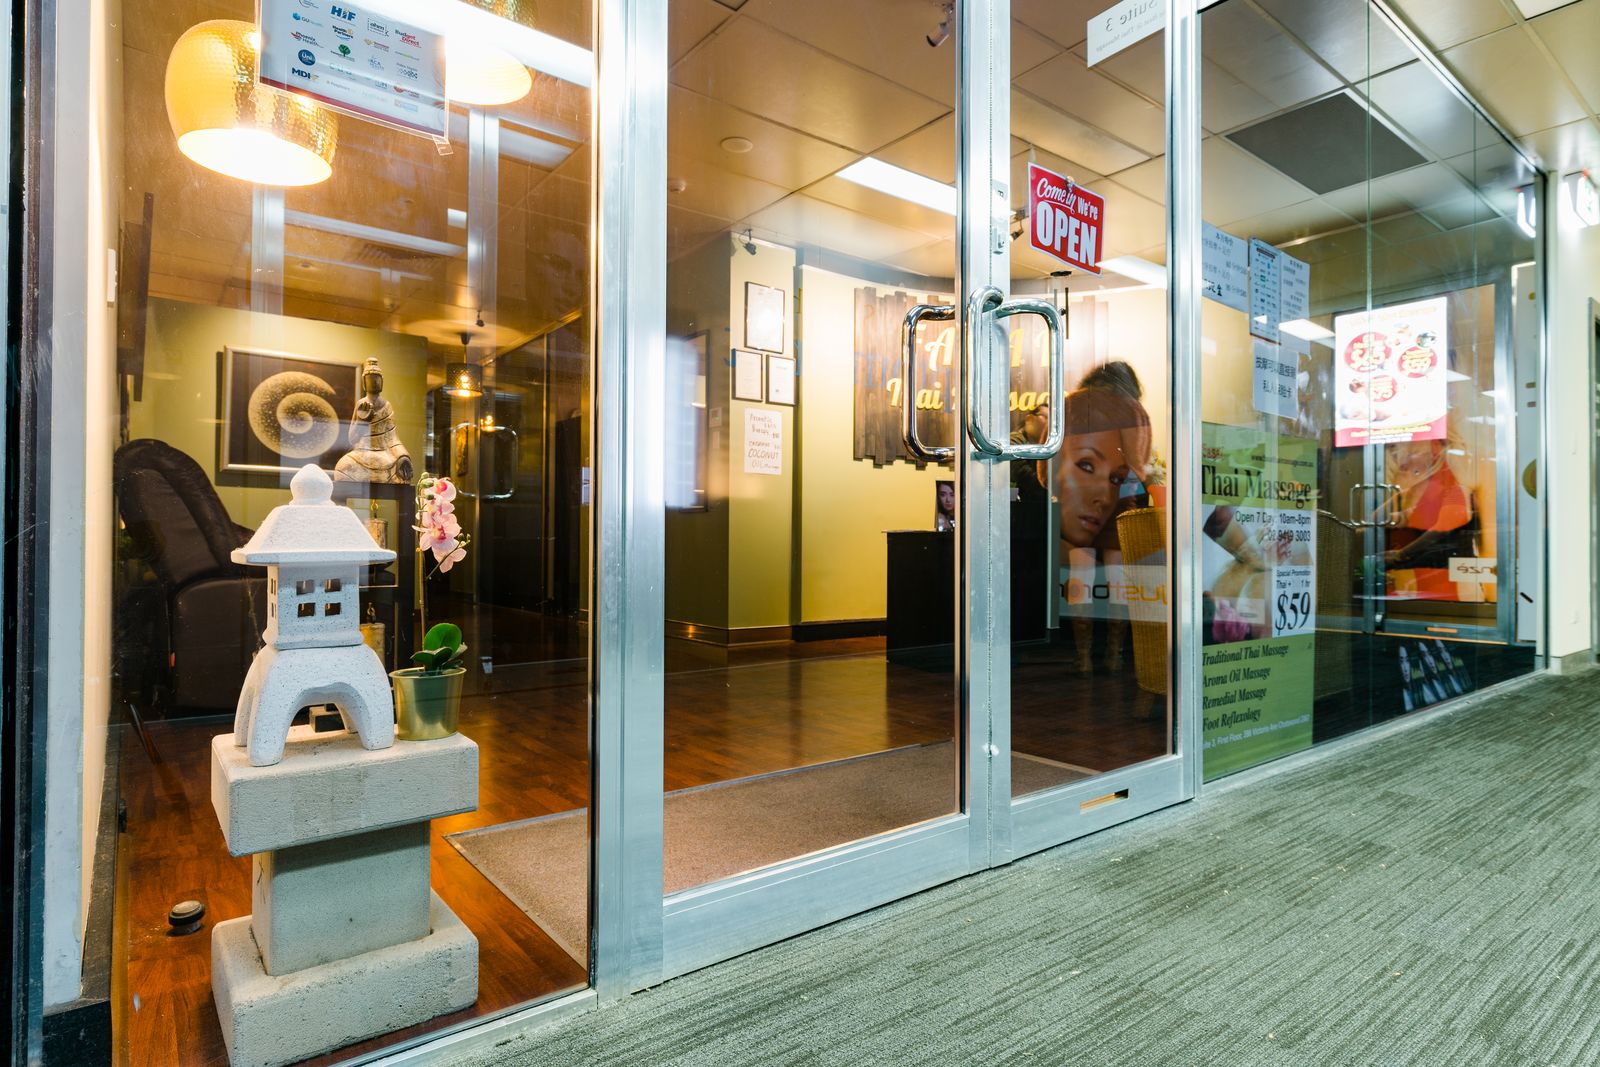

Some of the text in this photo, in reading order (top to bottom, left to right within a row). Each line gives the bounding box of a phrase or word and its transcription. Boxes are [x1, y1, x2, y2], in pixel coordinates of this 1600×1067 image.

[1036, 177, 1067, 203] Come
[1077, 196, 1099, 221] We're
[1036, 200, 1097, 268] OPEN
[1201, 464, 1311, 509] Thai Massage
[1235, 510, 1255, 525] Open
[1275, 590, 1312, 636] $59
[1202, 644, 1289, 667] Traditional Thai Massage
[1203, 667, 1271, 688] Aroma Oil Massage
[1202, 688, 1267, 710] Remedial Massage
[1203, 717, 1220, 732] Foot
[1220, 707, 1262, 729] Reflexology
